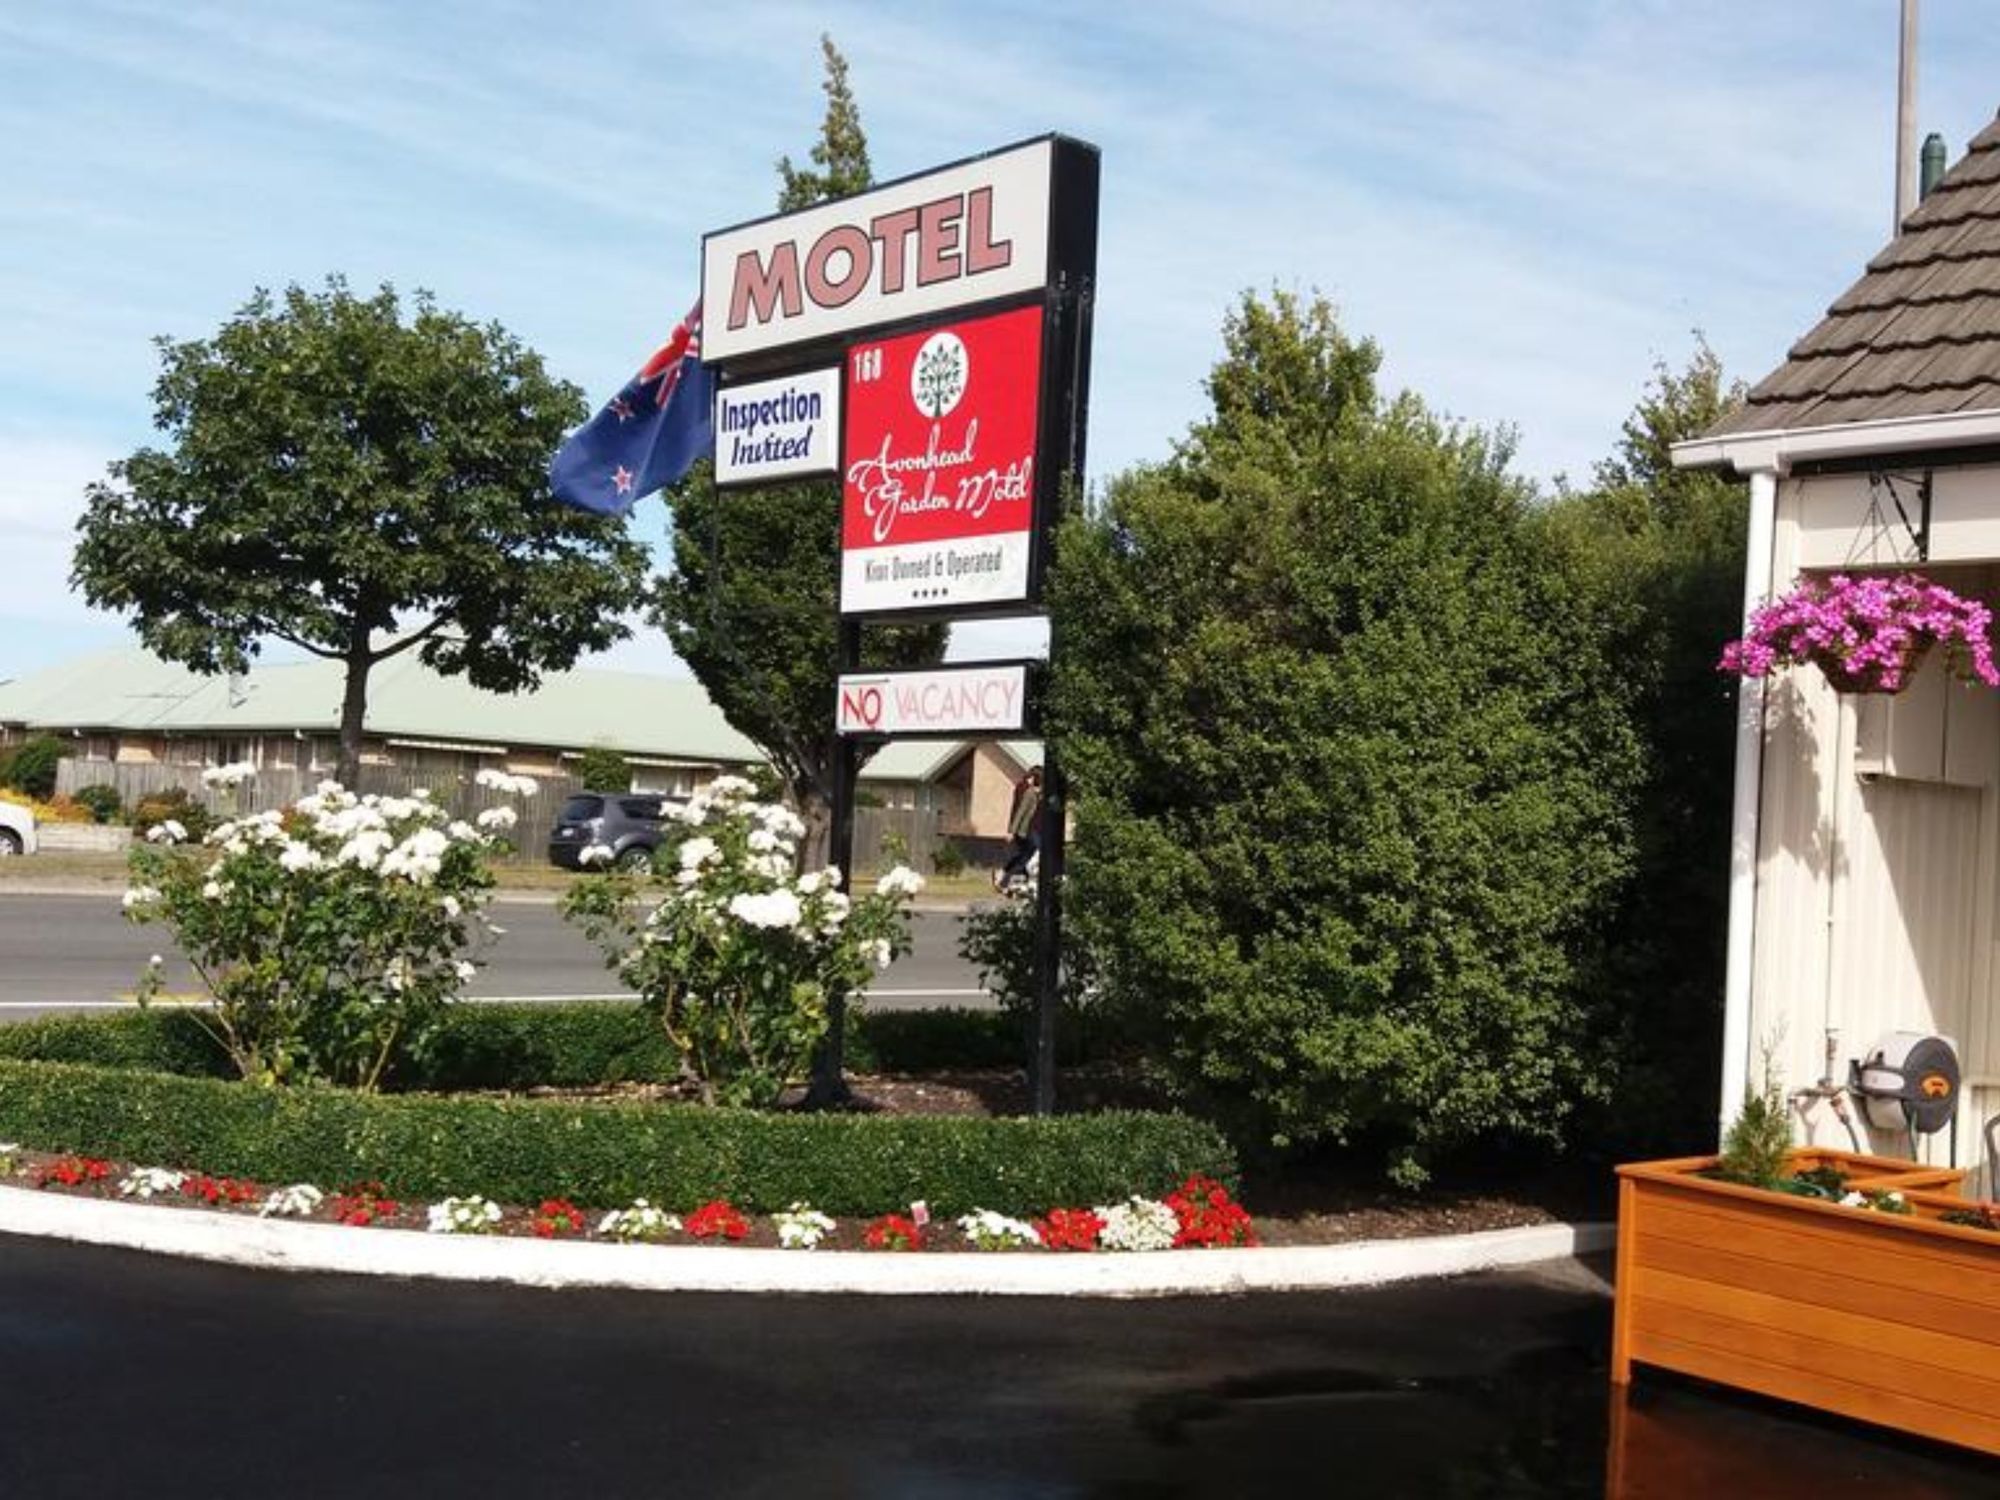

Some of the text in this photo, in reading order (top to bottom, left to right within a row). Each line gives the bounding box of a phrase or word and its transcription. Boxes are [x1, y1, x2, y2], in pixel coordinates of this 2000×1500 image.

[727, 185, 1012, 331] MOTEL
[721, 387, 822, 436] Inspection
[730, 426, 813, 467] Invited
[847, 417, 978, 492] Avonhead
[864, 455, 1032, 542] Garden Motel
[892, 553, 931, 581] Owned
[947, 544, 1003, 580] Operated
[842, 678, 1019, 726] NO VACANCY
